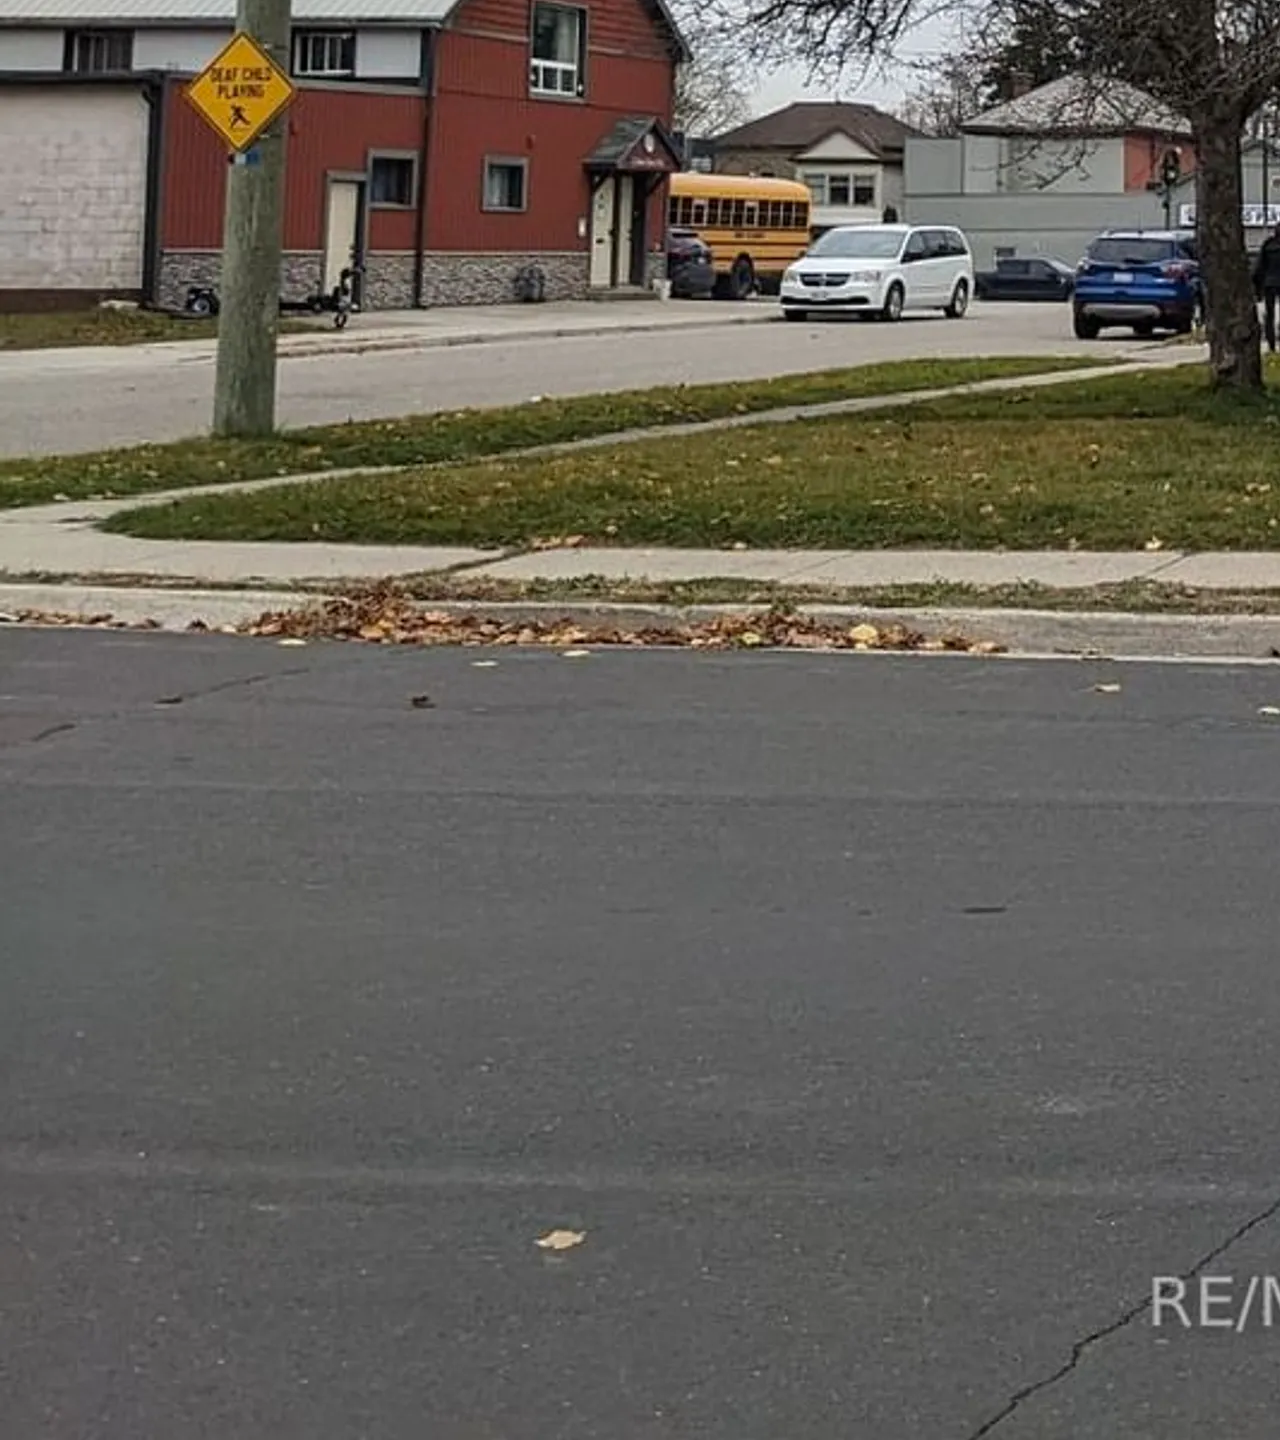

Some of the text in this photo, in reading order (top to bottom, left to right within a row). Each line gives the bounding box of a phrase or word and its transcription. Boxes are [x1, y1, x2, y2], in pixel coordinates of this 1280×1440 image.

[211, 66, 271, 82] DEAF CHILD
[217, 83, 266, 99] PLAYING
